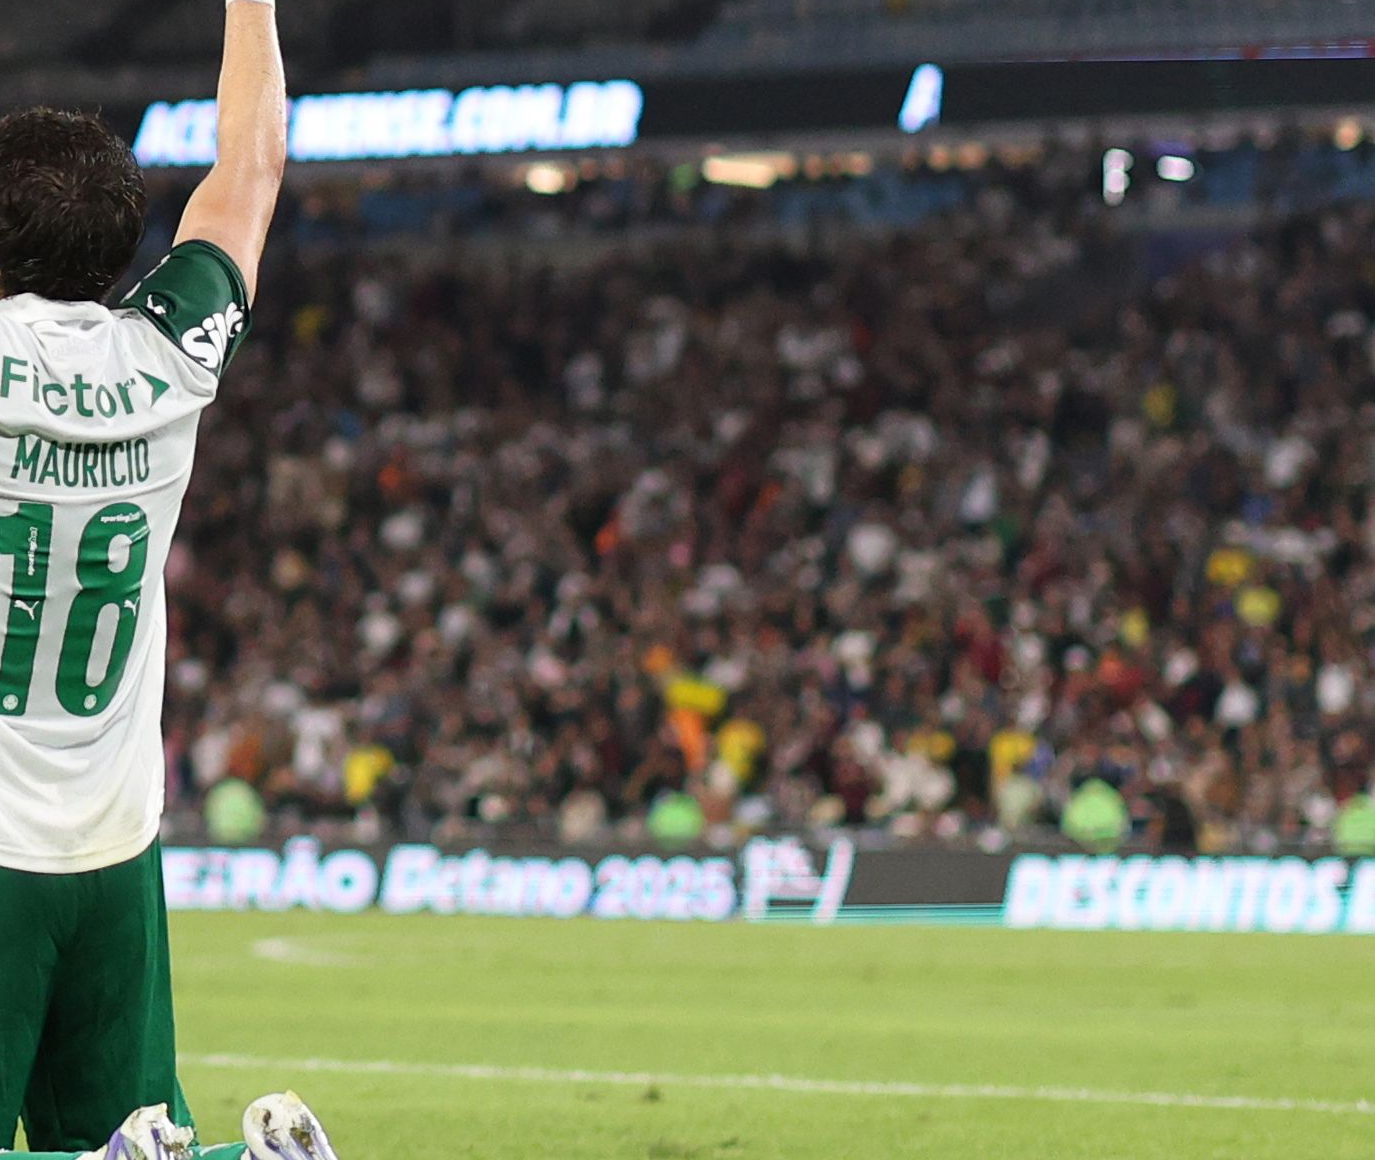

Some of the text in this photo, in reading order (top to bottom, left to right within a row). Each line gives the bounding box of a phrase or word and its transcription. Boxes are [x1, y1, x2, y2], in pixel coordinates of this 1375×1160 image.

[0, 354, 136, 418] Fictor
[379, 844, 591, 920] Betano
[592, 854, 738, 921] 2025
[1002, 854, 1349, 933] DESCONTOS
